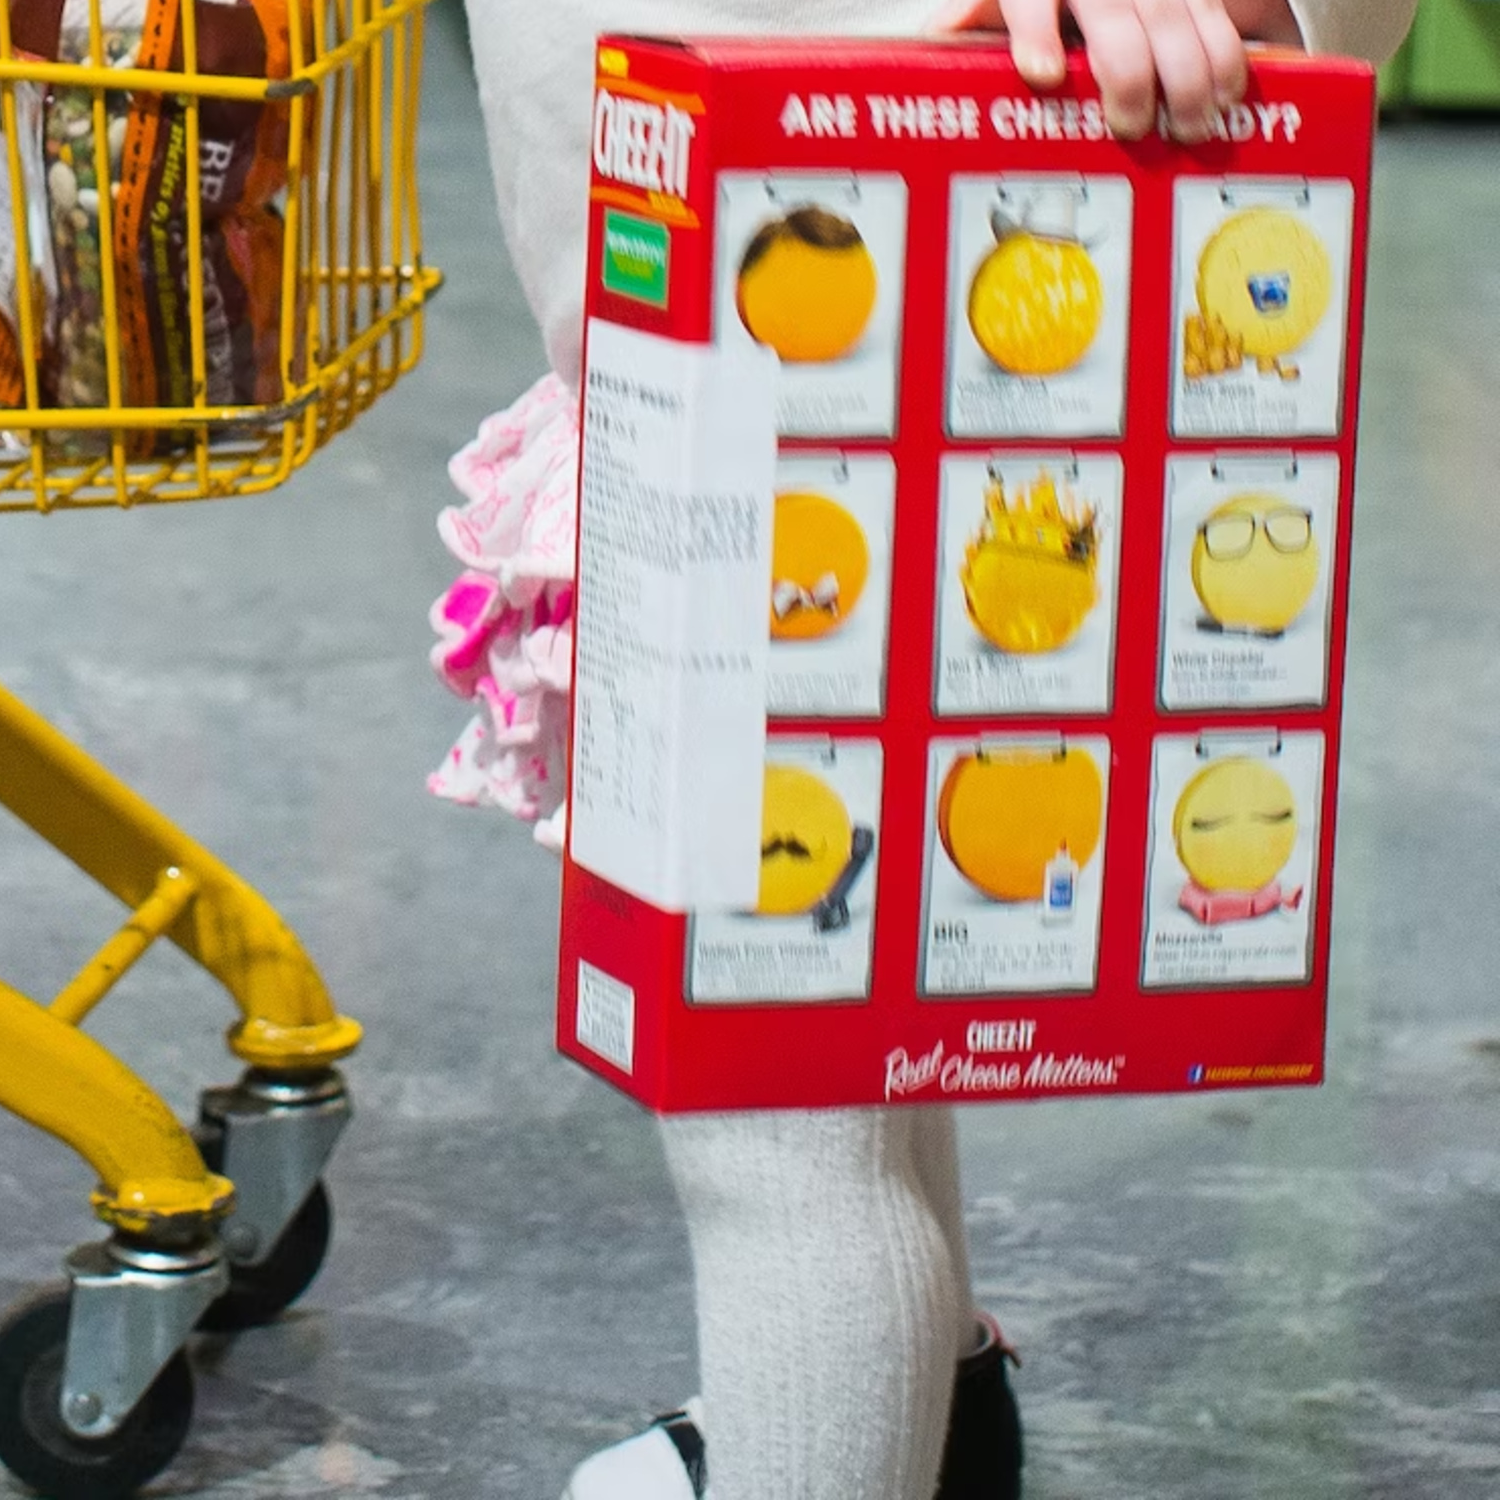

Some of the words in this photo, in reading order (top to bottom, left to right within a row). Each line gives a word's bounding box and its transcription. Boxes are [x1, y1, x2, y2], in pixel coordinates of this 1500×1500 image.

[779, 92, 858, 139] ARE
[865, 93, 982, 140] THESE
[988, 96, 1120, 141] CHEES
[884, 1039, 944, 1102] Real
[939, 1053, 1020, 1093] Cheese
